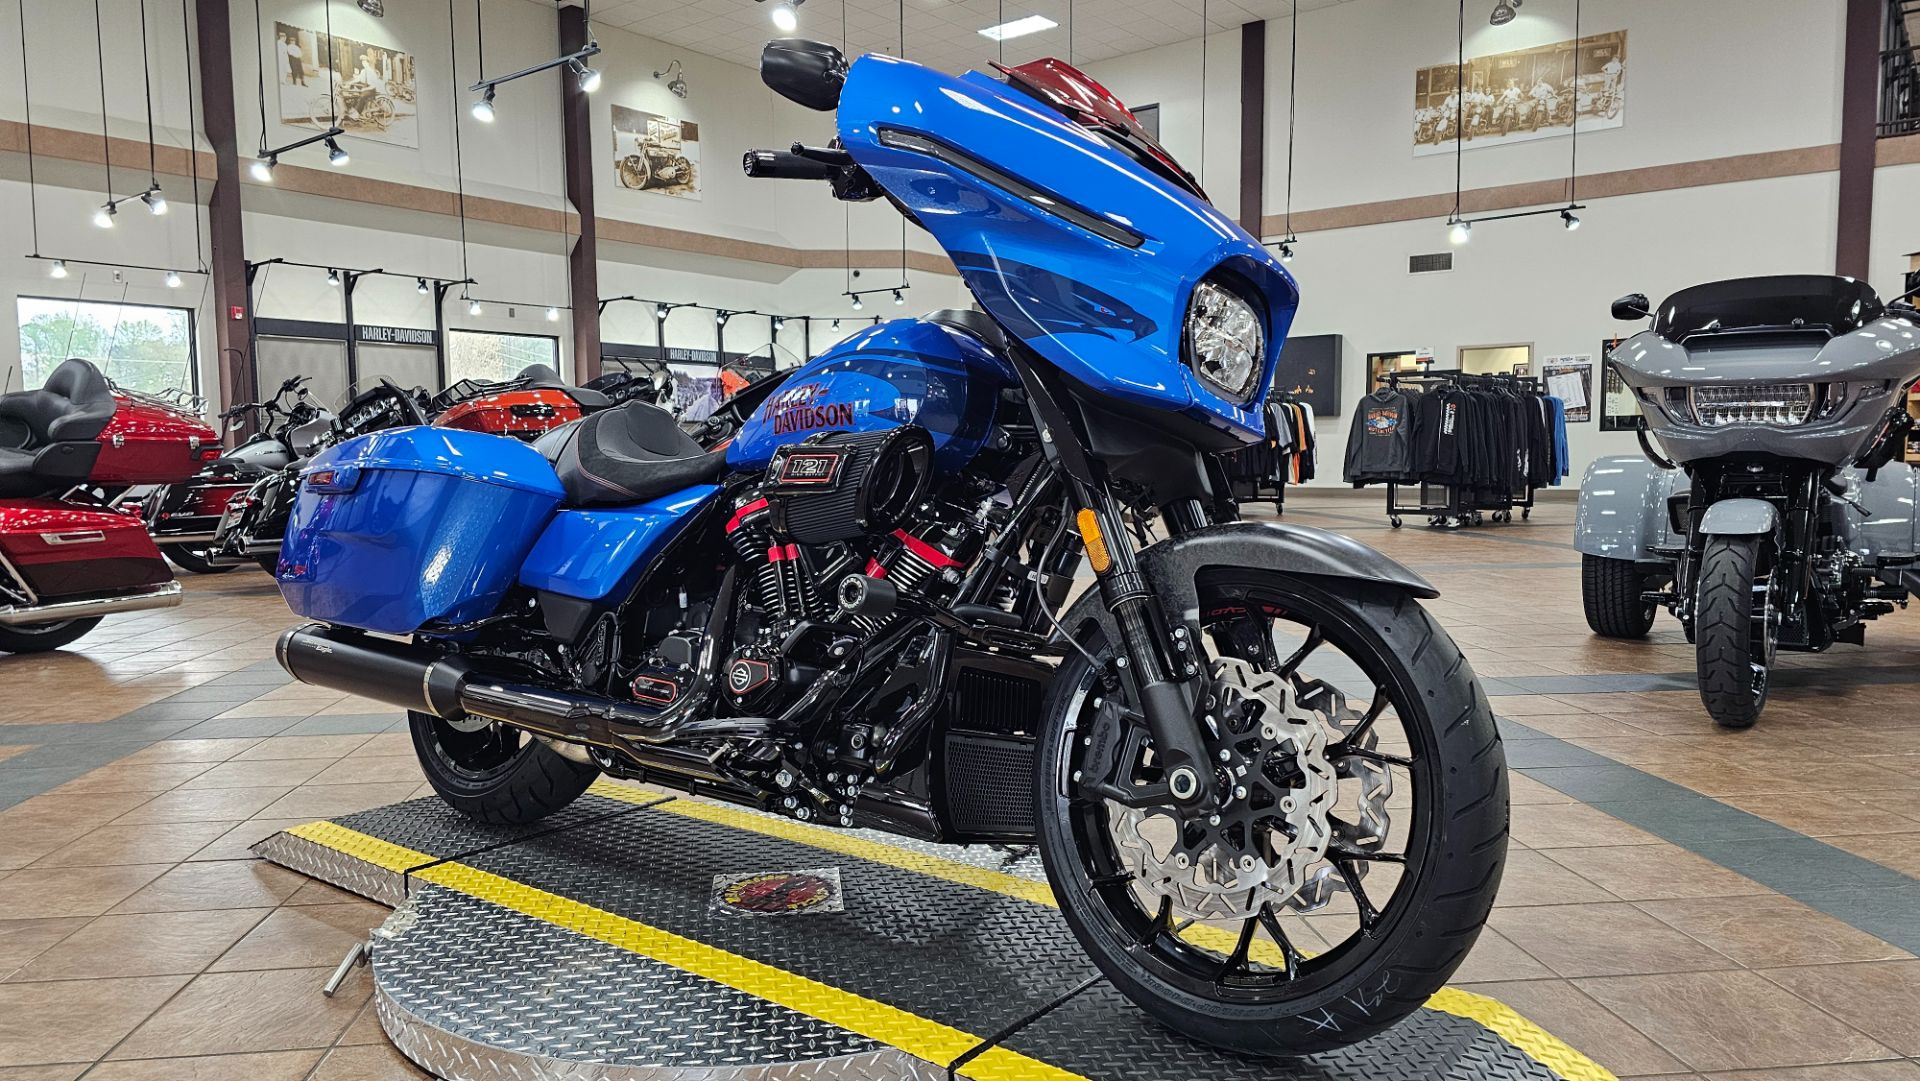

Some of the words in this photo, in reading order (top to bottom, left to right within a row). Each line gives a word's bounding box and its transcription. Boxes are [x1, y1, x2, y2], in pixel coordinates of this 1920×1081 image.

[362, 326, 432, 344] HARLEY-DAVIDSON
[670, 349, 717, 362] HARLEY-DAVIDSON
[774, 403, 853, 435] DAVIDSON
[791, 459, 828, 473] 121
[1088, 722, 1110, 774] brembo
